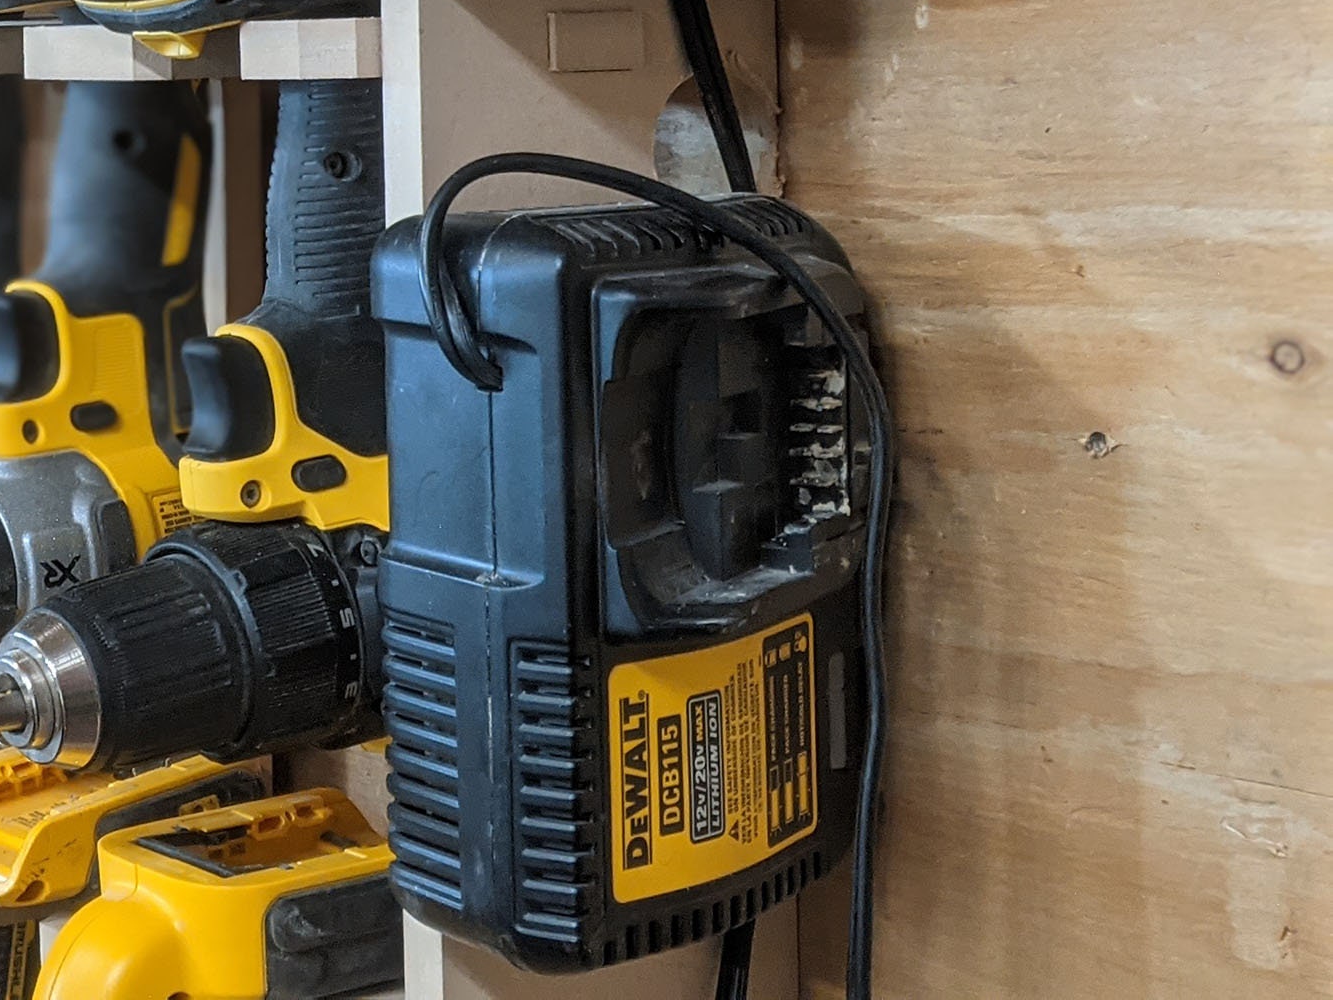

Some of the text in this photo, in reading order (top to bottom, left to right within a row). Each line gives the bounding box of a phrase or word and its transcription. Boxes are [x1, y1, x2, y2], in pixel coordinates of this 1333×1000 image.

[40, 555, 81, 588] XR
[339, 607, 356, 629] 5
[695, 704, 705, 741] MAX
[622, 697, 650, 869] DEWALT
[661, 725, 681, 826] DCB115
[707, 702, 720, 827] LITHIUM ION
